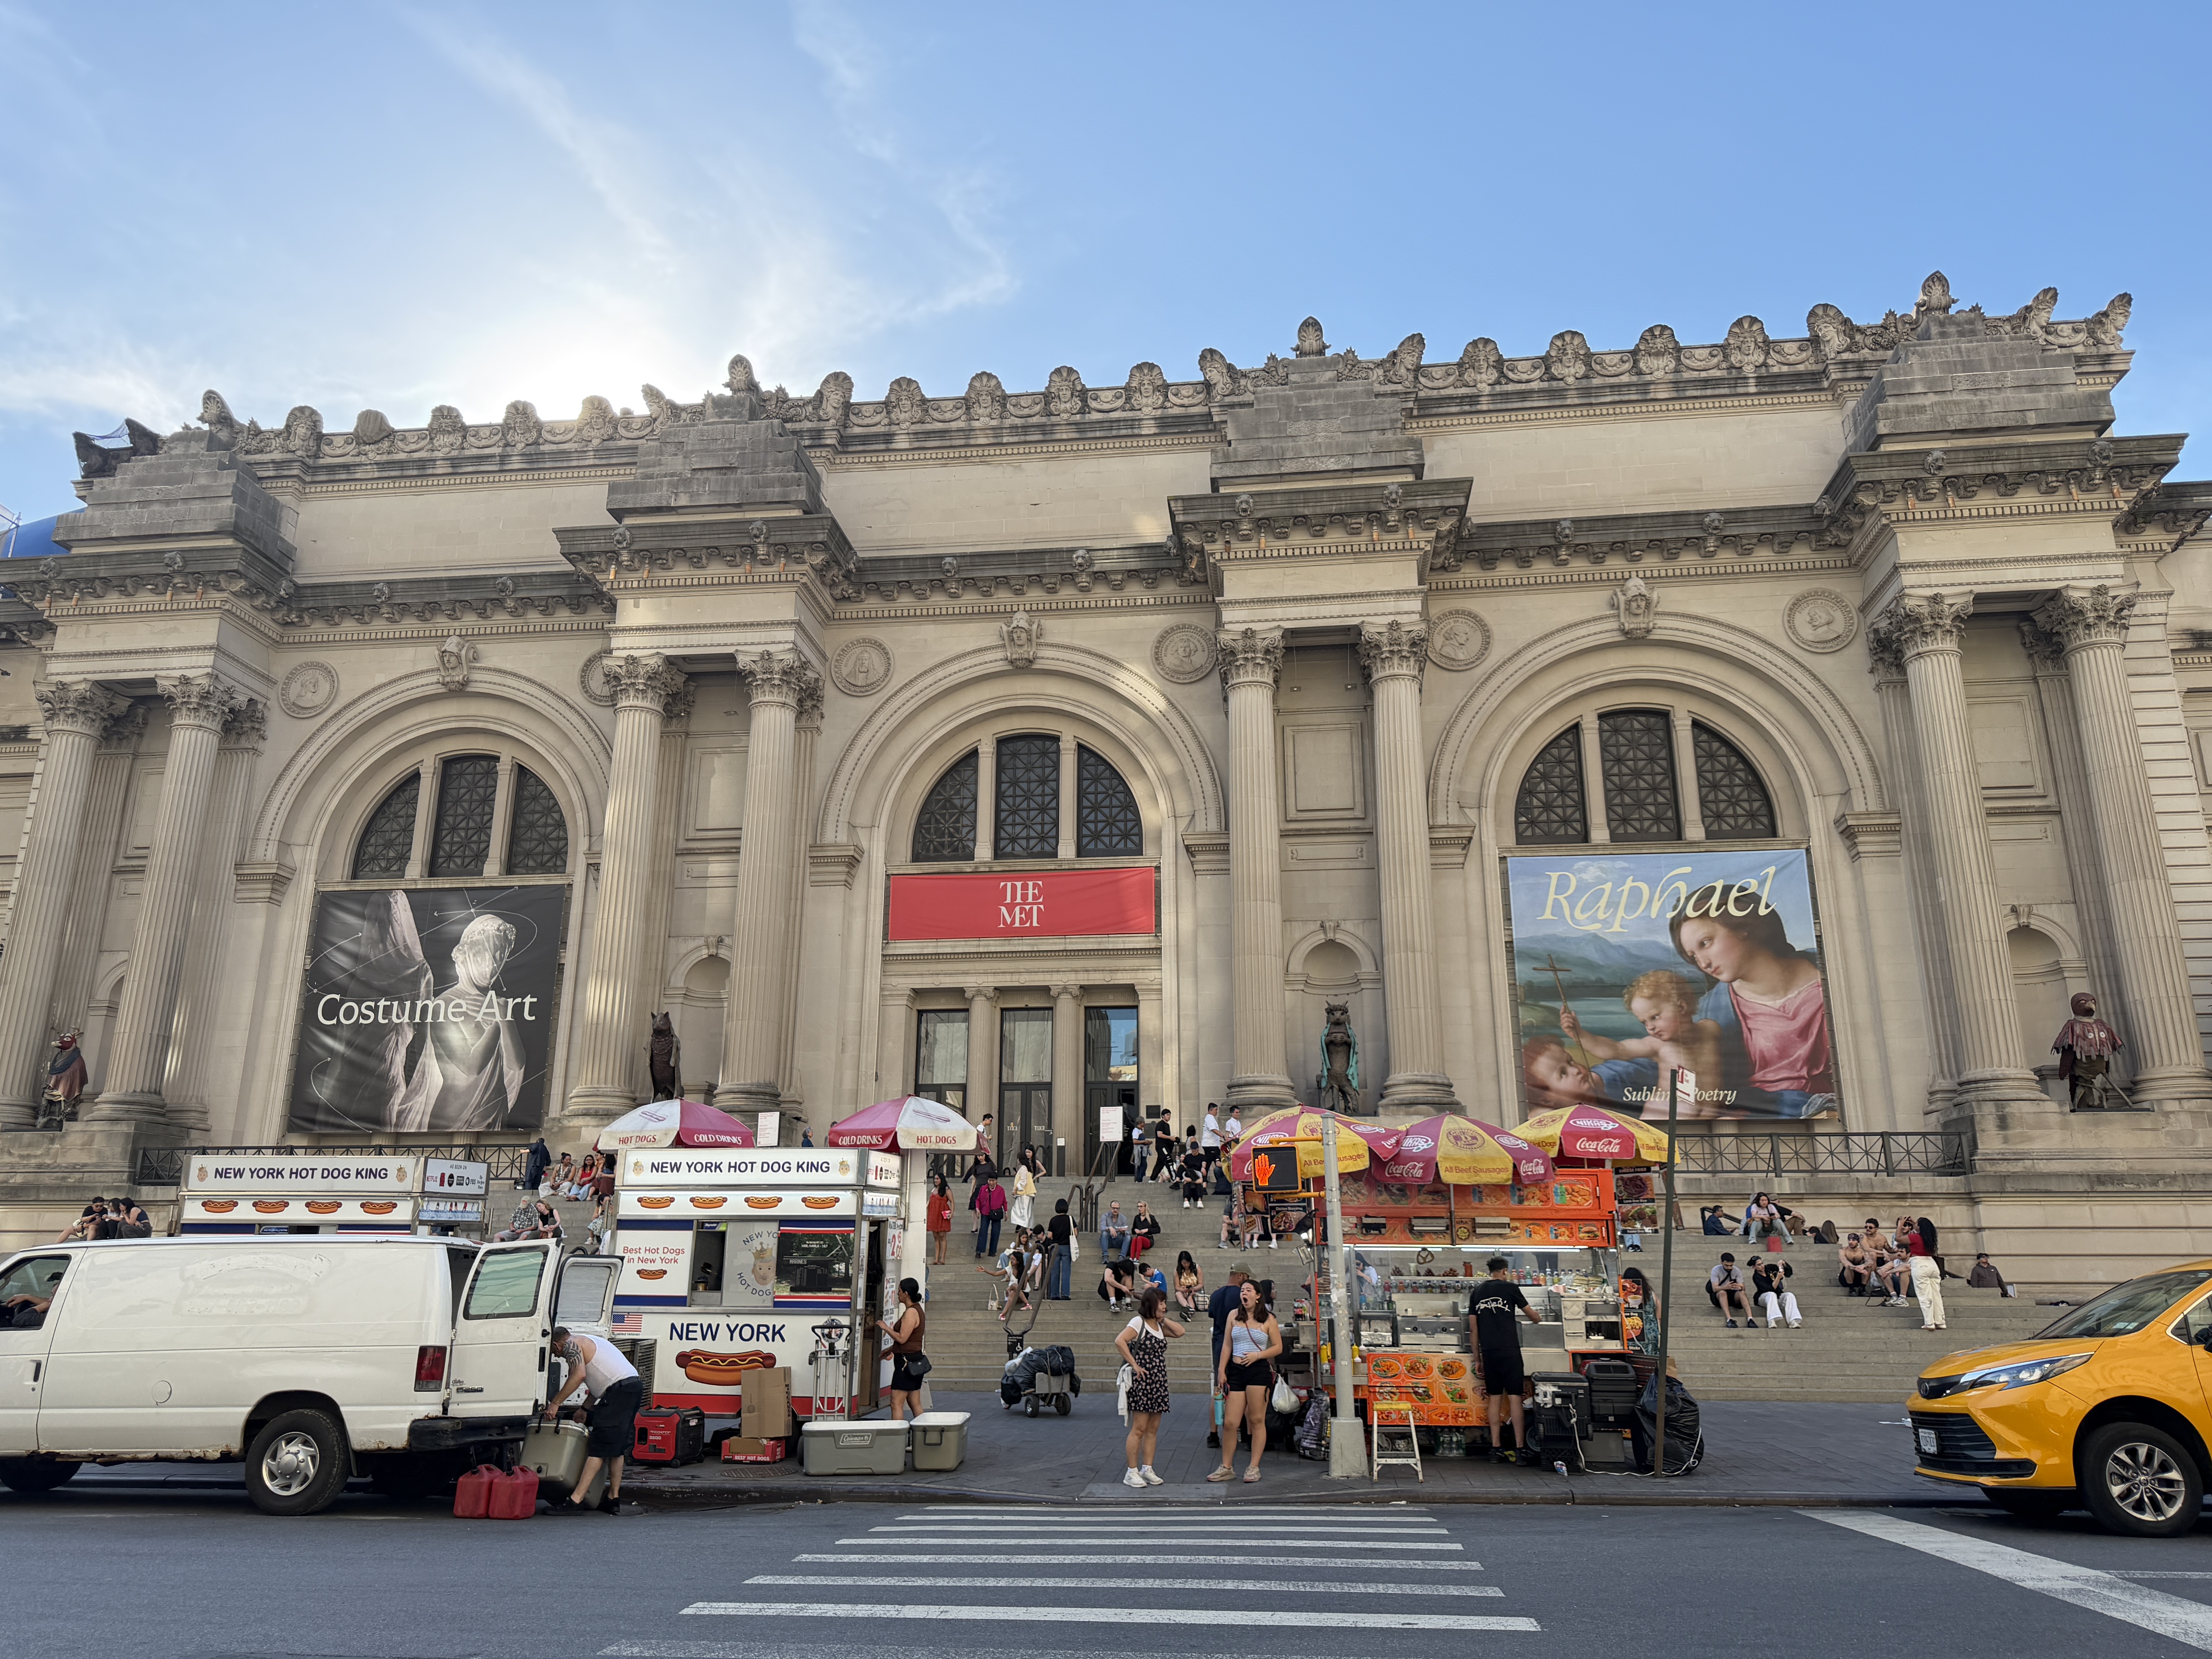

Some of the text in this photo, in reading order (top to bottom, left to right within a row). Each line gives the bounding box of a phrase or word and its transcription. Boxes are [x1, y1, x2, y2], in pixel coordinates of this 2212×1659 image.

[1000, 881, 1044, 903] THE
[1536, 866, 1777, 932] Raphael
[998, 905, 1044, 927] MET
[317, 990, 538, 1025] Costume Art
[1623, 1086, 1682, 1101] Sublim
[618, 1135, 657, 1145] HOT DOGS
[694, 1134, 742, 1145] COLD DRINKS
[838, 1135, 882, 1145] COLD DRINKS
[917, 1135, 957, 1144] HOT DOGS
[1576, 1137, 1622, 1152] Coca-Cola
[1337, 1153, 1365, 1162] ausages
[214, 1167, 388, 1180] NEW YORK HOT DOG KING
[651, 1161, 830, 1173] NEW YORK HOT DOG KING
[1385, 1161, 1426, 1178] Coca-Cola
[1473, 1166, 1509, 1175] Sausages
[743, 1231, 778, 1245] NEW YO
[644, 1246, 659, 1254] Hot
[663, 1247, 685, 1255] Dogs
[737, 1272, 771, 1297] HOT DOG
[670, 1322, 786, 1343] NEW YORK
